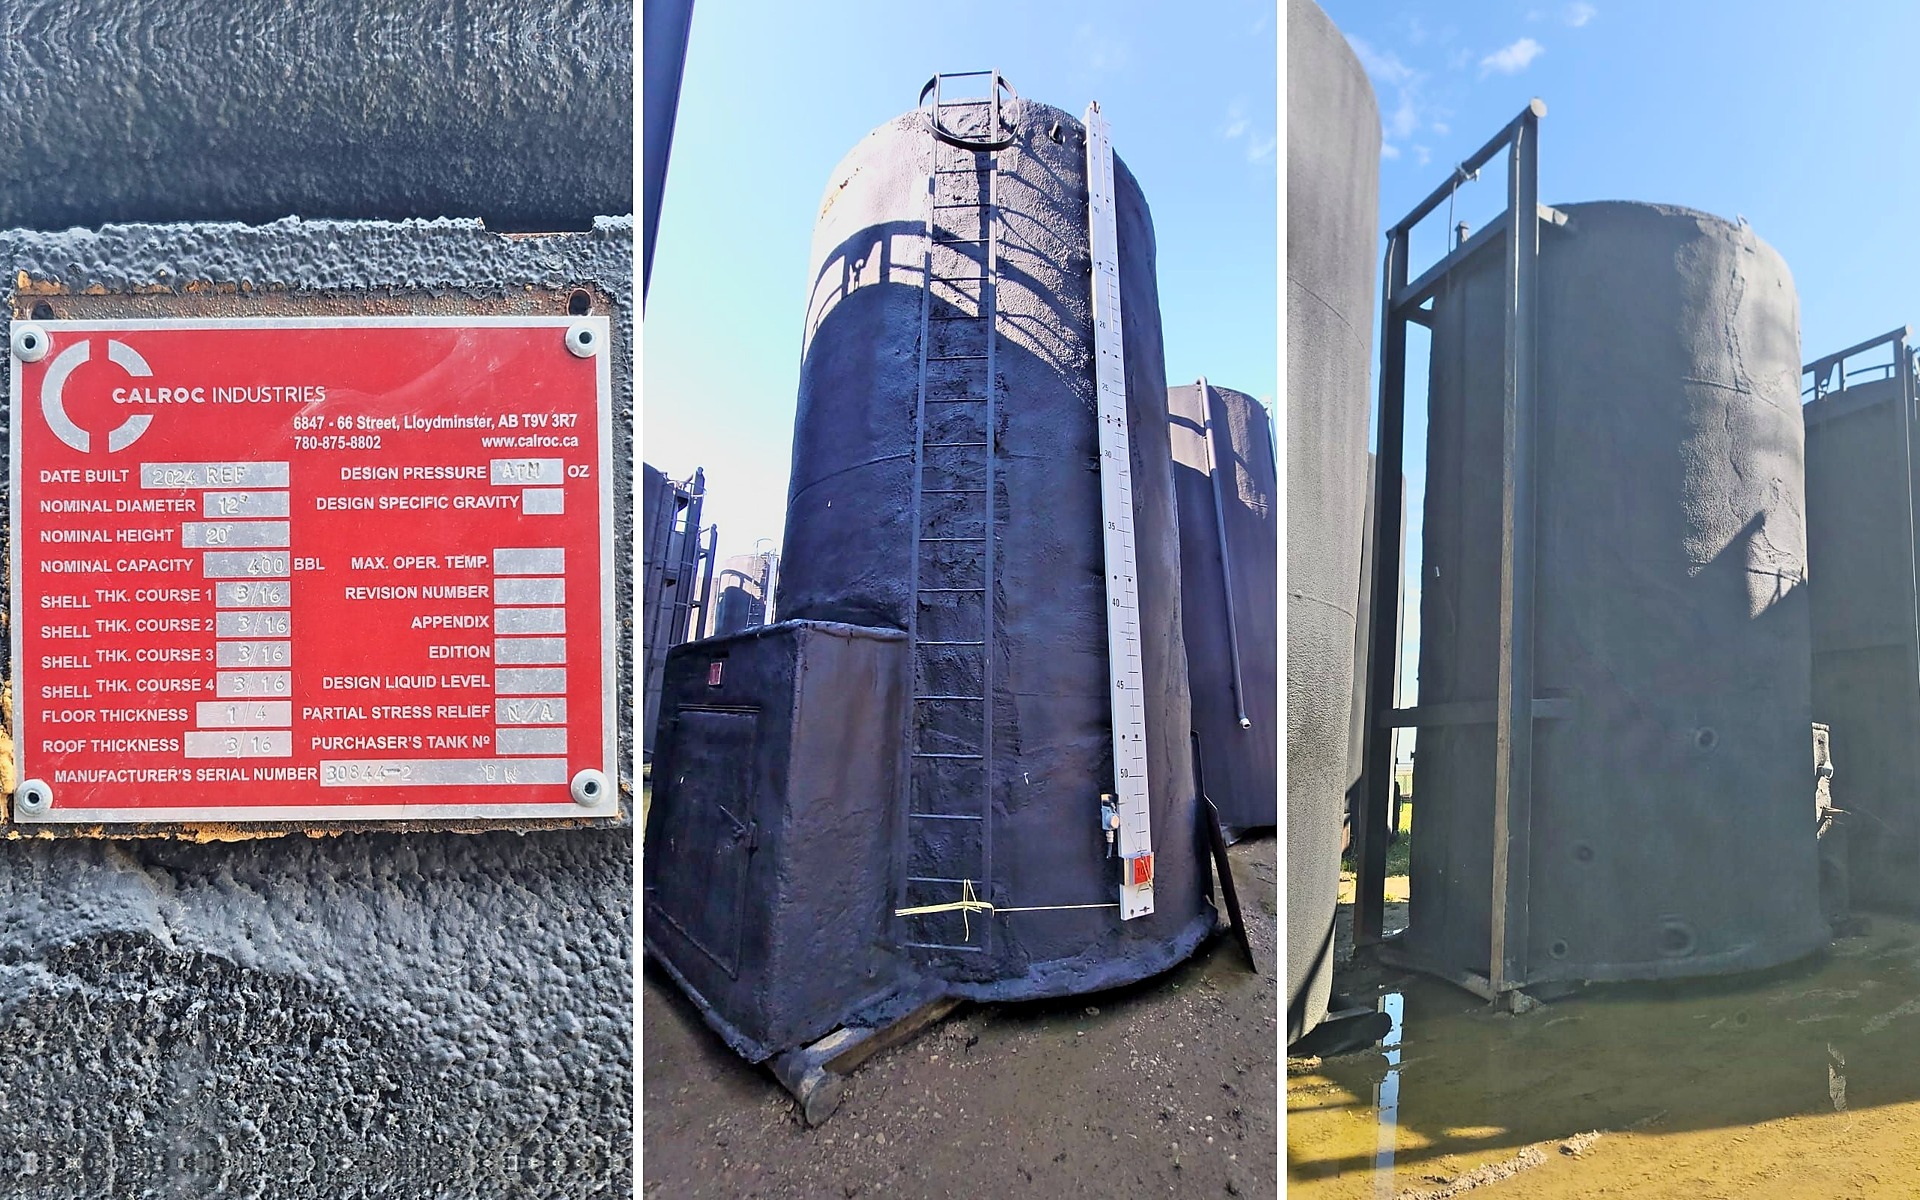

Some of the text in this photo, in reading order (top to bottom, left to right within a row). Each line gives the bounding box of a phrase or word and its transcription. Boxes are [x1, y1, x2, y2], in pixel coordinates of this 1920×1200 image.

[111, 384, 329, 405] CALROC INDUSTRIES
[293, 415, 325, 431] 6847
[336, 414, 354, 431] 66
[356, 414, 401, 432] Street,
[403, 412, 495, 433] Lloydminster,
[497, 413, 519, 428] AB
[521, 413, 549, 428] T9V
[550, 413, 578, 428] 3R7
[293, 434, 382, 450] 780-875-8802
[481, 433, 579, 448] www.calroc.ca
[39, 466, 246, 486] DATE BUILT 2024 REF
[340, 461, 591, 481] DESIGN PRESSURE ATM OZ
[40, 499, 113, 513] NOMINAL
[116, 498, 197, 513] DIAMETER
[316, 495, 520, 511] DESIGN SPECIFIC GRAVITY
[40, 529, 113, 543] NOMINAL
[116, 528, 175, 543] HEIGHT
[40, 557, 326, 575] NOMINAL CAPACITY 400 BBL
[351, 554, 490, 570] MAX. OPER. TEMP.
[40, 595, 92, 609] SHELL
[94, 589, 132, 603] THK.
[135, 588, 201, 602] COURSE
[205, 588, 212, 601] 1
[345, 585, 490, 600] REVISION NUMBER
[41, 625, 92, 639] SHELL
[94, 619, 132, 633] THK.
[135, 618, 201, 632] COURSE
[204, 618, 214, 632] 2
[410, 615, 490, 629] APPENDIX
[41, 655, 92, 669] SHELL
[95, 649, 132, 663] THK.
[135, 648, 202, 662] COURSE
[205, 648, 214, 662] 3
[428, 645, 491, 659] EDITION
[41, 685, 93, 699] SHELL
[95, 679, 132, 693] THK.
[136, 678, 202, 692] COURSE
[204, 678, 215, 691] 4
[322, 674, 491, 690] DESIGN LIQUID LEVEL
[1116, 680, 1125, 690] 45
[42, 709, 97, 723] FLOOR
[99, 708, 189, 723] THICKNESS
[302, 701, 554, 722] PARTIAL STRESS RELIEF N/A
[42, 739, 87, 753] ROOF
[90, 738, 180, 753] THICKNESS
[425, 735, 469, 749] TANK
[196, 767, 250, 782] SERIAL
[253, 767, 318, 781] NUMBER
[1120, 768, 1129, 779] 50
